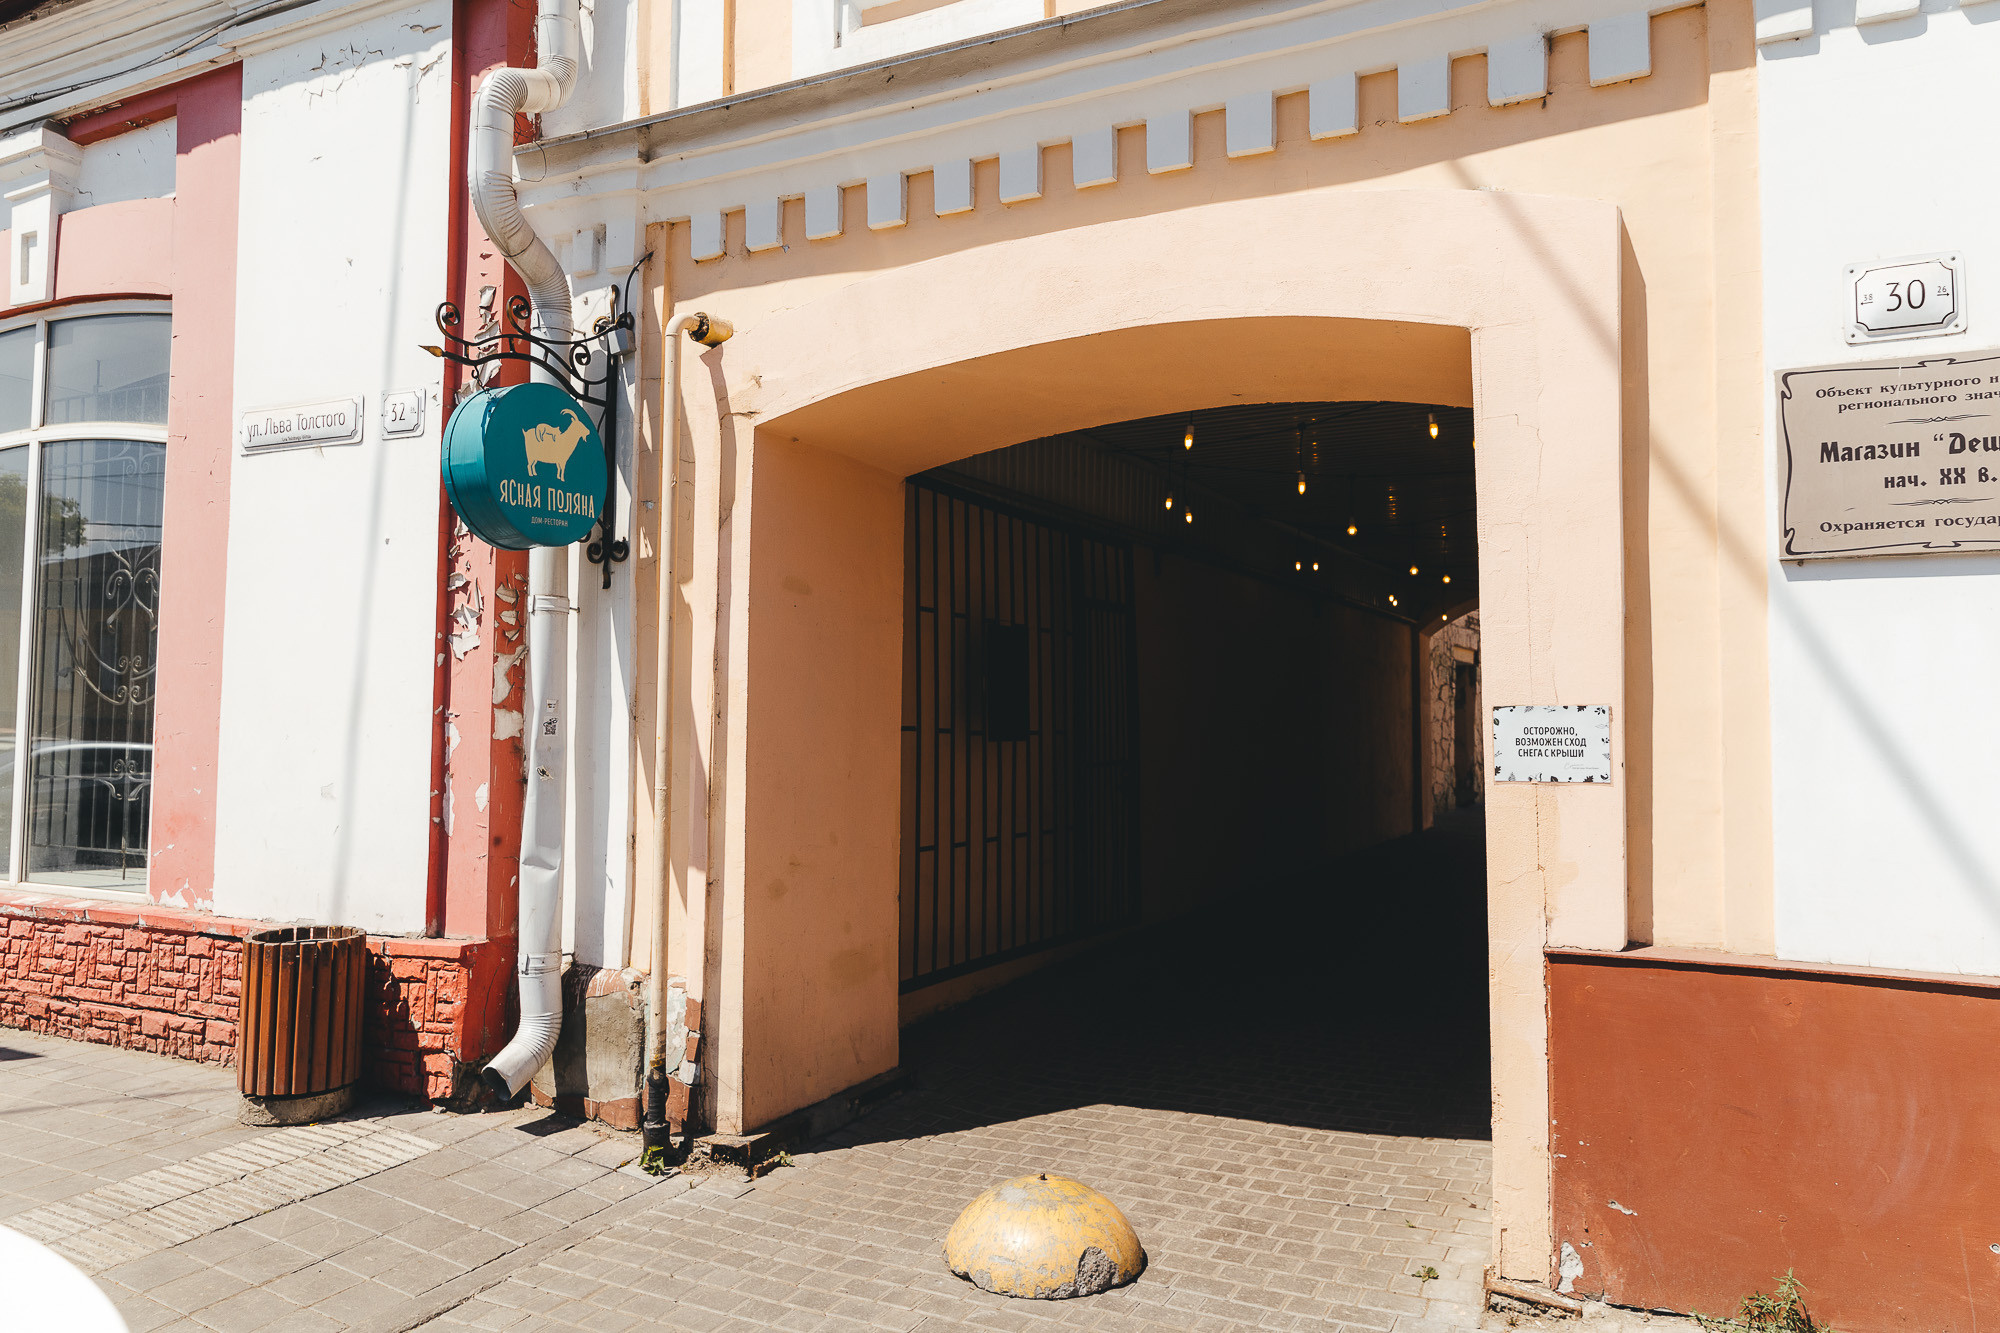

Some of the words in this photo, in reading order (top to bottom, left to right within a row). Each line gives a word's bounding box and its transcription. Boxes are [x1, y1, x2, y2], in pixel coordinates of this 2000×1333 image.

[1886, 279, 1926, 312] 30
[1937, 285, 1947, 294] 26
[1815, 386, 1873, 399] Объект
[1880, 376, 1981, 395] культурного
[391, 402, 406, 422] 32
[1838, 394, 1957, 414] регионального
[246, 421, 263, 443] ул.
[264, 417, 292, 436] Льва
[296, 411, 346, 431] Толстого
[1820, 441, 1920, 464] Магазин
[1884, 474, 1928, 489] нач.
[500, 479, 541, 509] ЯСНАЯ
[547, 487, 595, 519] ПОЛЯНА
[1820, 518, 1925, 535] Охраняется
[1523, 726, 1578, 736] ОСТОРОЖНО,
[1515, 737, 1563, 747] ВОЗМОЖЕН
[1564, 737, 1587, 748] СХОД
[1518, 748, 1543, 758] СНЕГА
[1544, 748, 1550, 758] С
[1551, 748, 1584, 758] КРЫШИ
